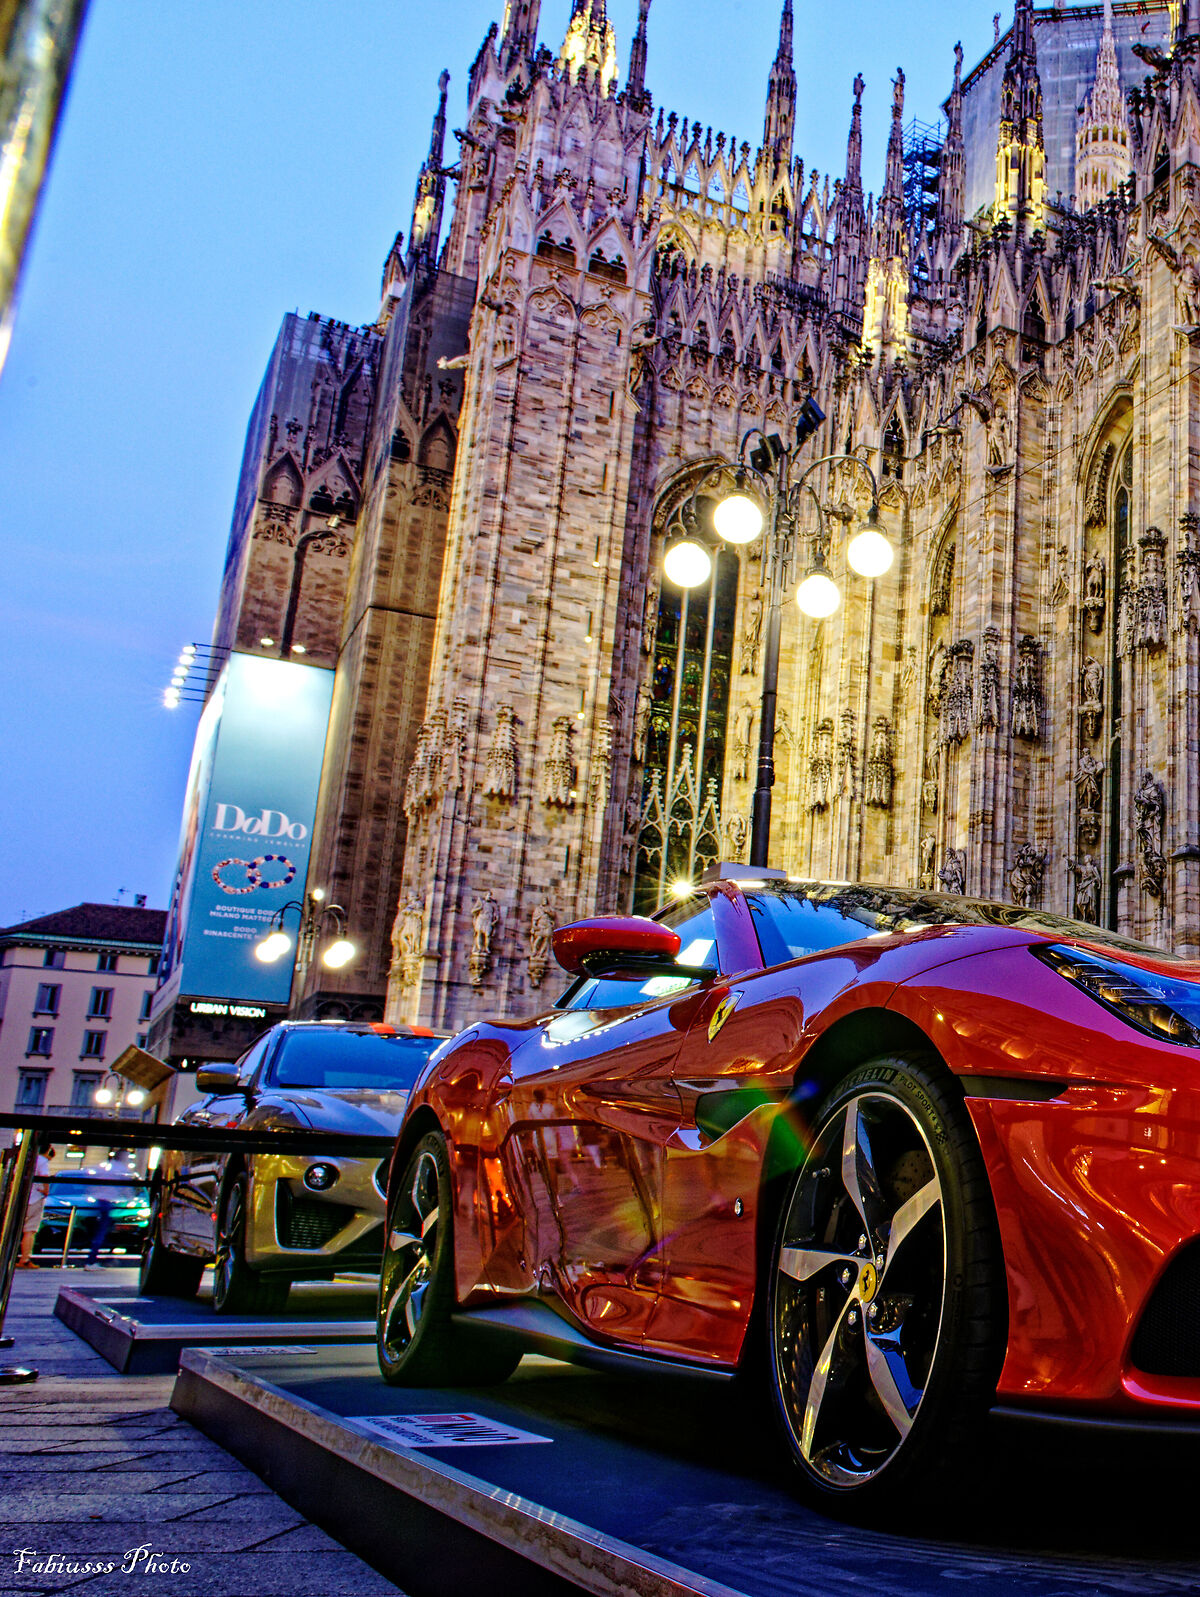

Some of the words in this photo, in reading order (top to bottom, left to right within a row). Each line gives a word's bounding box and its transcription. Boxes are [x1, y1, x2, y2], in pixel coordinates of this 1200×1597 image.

[212, 803, 307, 840] DoDo
[215, 904, 256, 914] BOUTIQUE
[209, 910, 240, 920] MILANO
[203, 929, 252, 940] RINASCENTE
[233, 926, 257, 934] DODO
[190, 1002, 228, 1015] URBAN
[229, 1005, 266, 1018] VISION
[916, 1090, 935, 1116] SPORT
